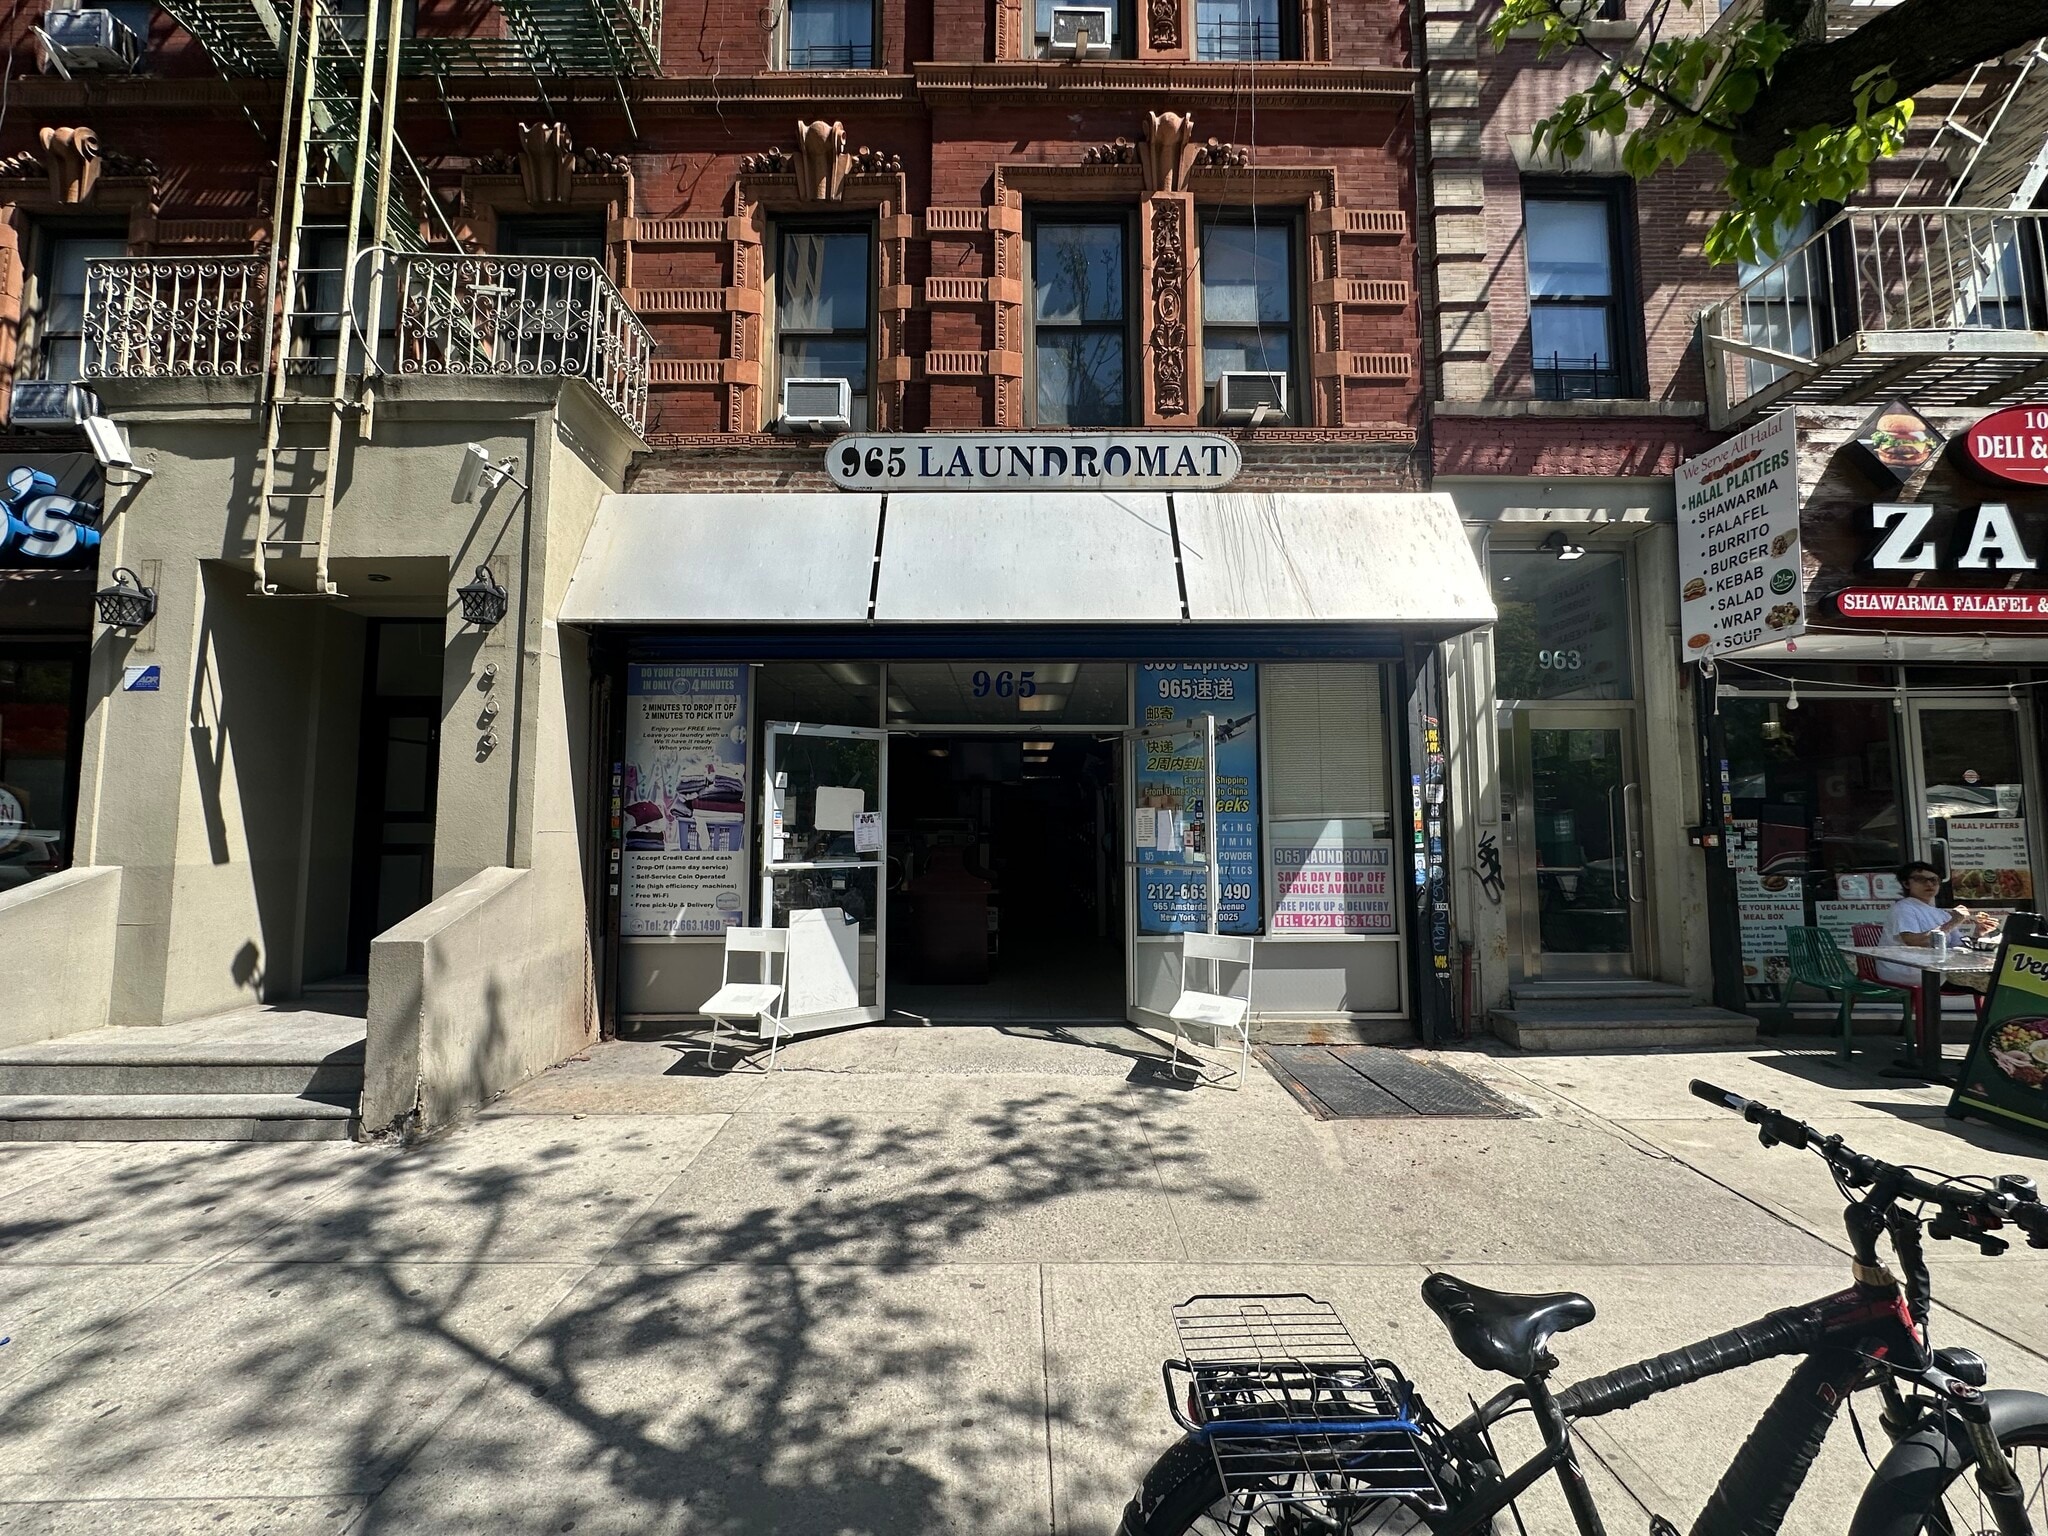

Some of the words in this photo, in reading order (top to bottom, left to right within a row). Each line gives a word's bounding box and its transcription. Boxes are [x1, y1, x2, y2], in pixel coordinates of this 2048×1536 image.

[1683, 464, 1699, 480] We
[1701, 450, 1729, 472] Serve
[1731, 435, 1747, 456] All
[1750, 416, 1783, 446] Halal
[1977, 435, 2025, 459] DELI
[2030, 435, 2047, 459] &
[841, 445, 906, 478] 965
[918, 445, 1227, 477] LAUNDROMAT
[1688, 483, 1723, 511] HALAL
[1726, 449, 1789, 493] PLATTERS
[1698, 478, 1778, 524] SHAWARMA
[1708, 503, 1769, 538] FALAFEL
[1708, 523, 1770, 557] BURRITO
[1711, 543, 1769, 575] BURGER
[1716, 566, 1764, 592] KEBAB
[1718, 586, 1764, 611] SALAD
[1843, 593, 1949, 611] SHAWARMA
[1952, 596, 2033, 613] FALAFEL
[2037, 597, 2048, 613] &
[1721, 607, 1762, 629] WRAP
[1724, 627, 1762, 648] SOUP
[1539, 649, 1582, 670] 963
[641, 668, 652, 678] DO
[654, 668, 674, 678] YOUR
[675, 668, 714, 678] COMPLETE
[715, 668, 739, 678] WASH
[643, 680, 651, 690] IN
[652, 680, 672, 690] ONLY
[691, 679, 700, 692] 4
[701, 680, 735, 690] MINUTES
[972, 670, 1037, 698] 965
[1159, 678, 1234, 699] 965速递
[645, 712, 650, 720] 2
[651, 712, 683, 720] MINUTES
[685, 712, 695, 720] TO
[696, 712, 714, 720] PICK
[715, 712, 722, 720] IT
[724, 712, 734, 720] UP
[1216, 776, 1248, 785] Shipping
[1145, 787, 1163, 796] From
[1166, 787, 1189, 796] United
[1217, 787, 1225, 796] to
[1227, 787, 1248, 796] China
[1186, 797, 1197, 812] 2
[1216, 797, 1250, 812] eeks
[1979, 822, 2020, 830] PLATTERS
[1219, 851, 1252, 860] POWDER
[1276, 850, 1300, 864] 965
[1304, 850, 1387, 864] LAUNDROMAT
[1277, 871, 1307, 883] SAME
[1310, 871, 1332, 883] DAY
[1334, 871, 1364, 883] DROP
[1367, 871, 1386, 883] OFF
[1147, 883, 1251, 900] 212-6631490
[1279, 883, 1325, 894] SERVICE
[1328, 883, 1385, 894] AVAILABLE
[1153, 903, 1168, 911] 965
[1170, 903, 1207, 911] Amsterda
[1217, 903, 1245, 911] Avenue
[1276, 901, 1297, 912] FREE
[1299, 901, 1321, 912] PICK
[1323, 901, 1335, 912] UP
[1338, 901, 1345, 912] &
[1347, 901, 1389, 912] DELIVERY
[1850, 903, 1891, 911] PLATTERS
[645, 920, 661, 931] Tel:
[663, 920, 721, 931] 212.663.1490
[1160, 913, 1176, 921] New
[1178, 913, 1198, 922] York,
[1218, 913, 1238, 921] 0025
[1276, 914, 1299, 927] TEL:
[1301, 914, 1331, 927] (212)
[1335, 914, 1390, 927] 663.1490
